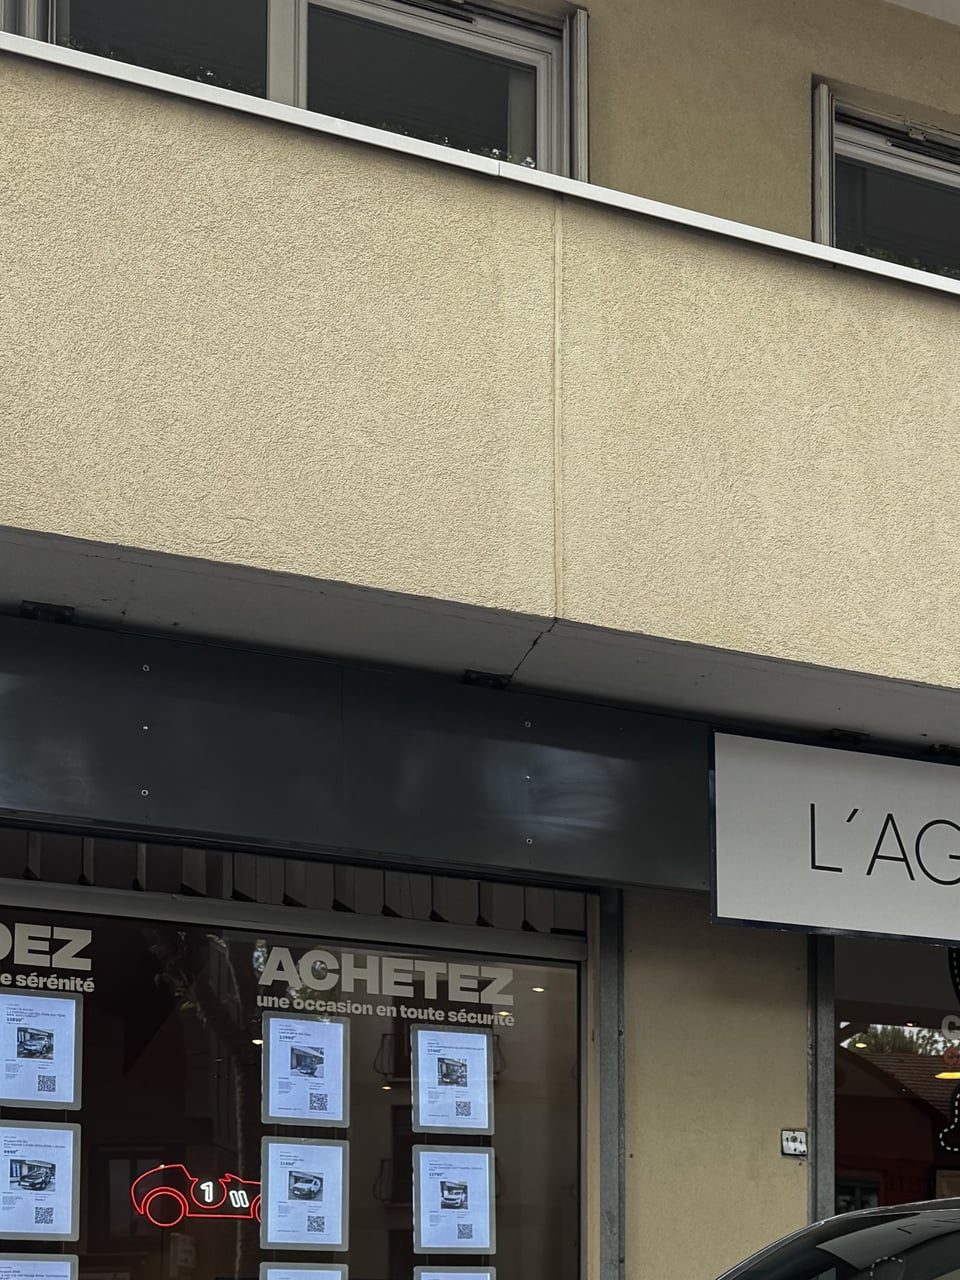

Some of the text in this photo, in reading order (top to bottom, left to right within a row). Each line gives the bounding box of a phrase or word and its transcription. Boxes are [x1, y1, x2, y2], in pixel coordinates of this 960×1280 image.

[15, 972, 95, 992] sérénité
[258, 946, 514, 1006] ACHETEZ
[256, 994, 516, 1026] une occasion en toute sécurité
